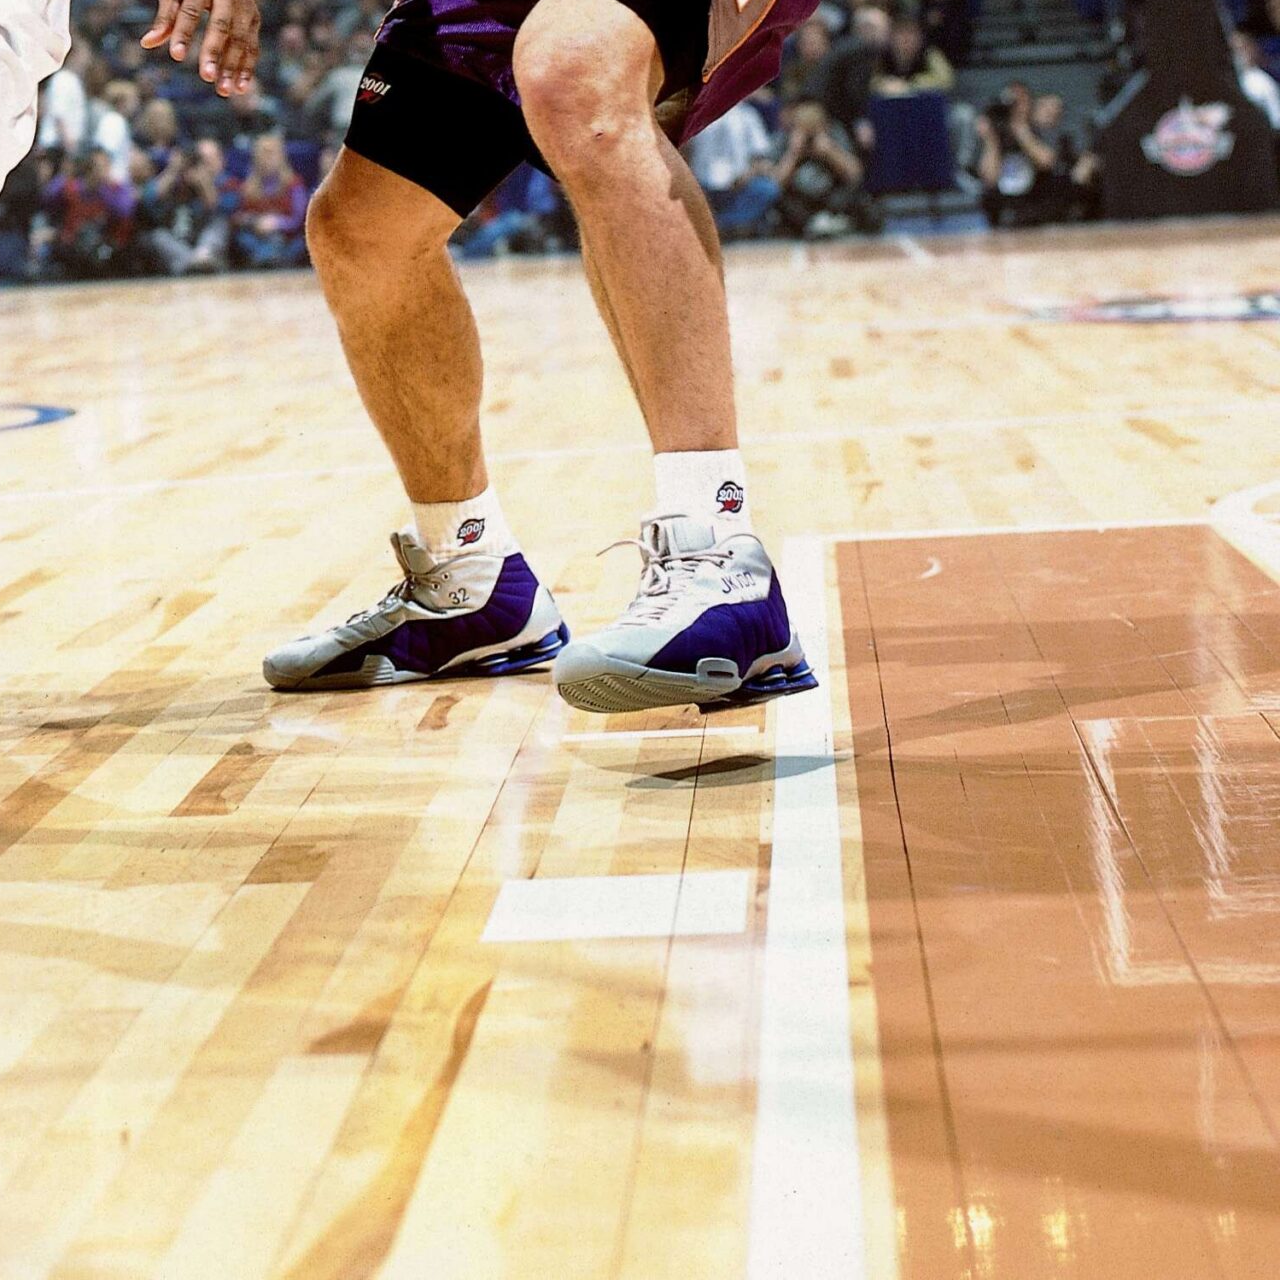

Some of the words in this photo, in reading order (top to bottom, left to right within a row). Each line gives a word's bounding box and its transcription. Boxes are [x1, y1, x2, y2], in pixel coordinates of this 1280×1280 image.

[360, 76, 392, 97] 2001
[459, 520, 484, 537] 2001
[448, 587, 470, 605] 32
